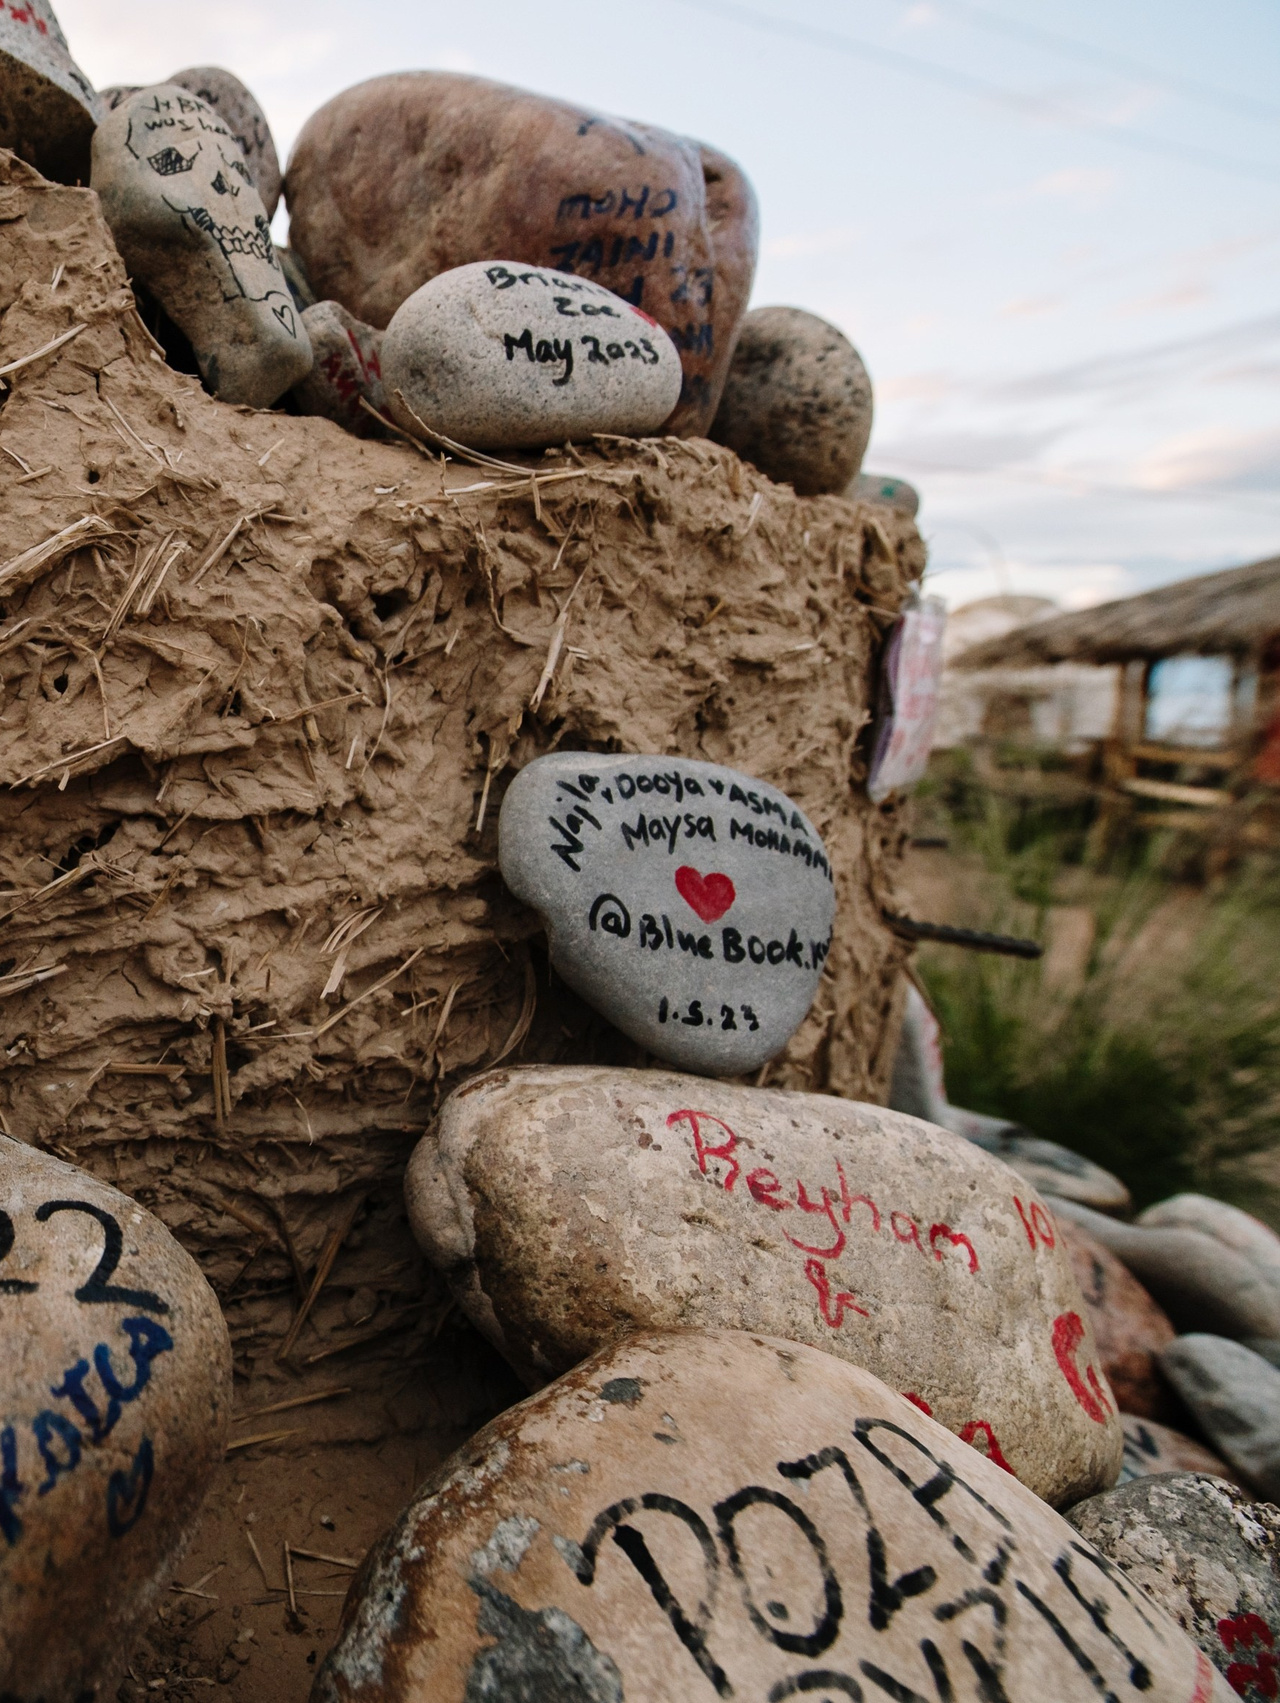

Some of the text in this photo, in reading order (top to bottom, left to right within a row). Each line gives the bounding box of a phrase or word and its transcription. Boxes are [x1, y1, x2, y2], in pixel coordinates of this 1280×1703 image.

[504, 328, 574, 386] May
[581, 335, 659, 365] 2023
[621, 813, 717, 855] Maysa
